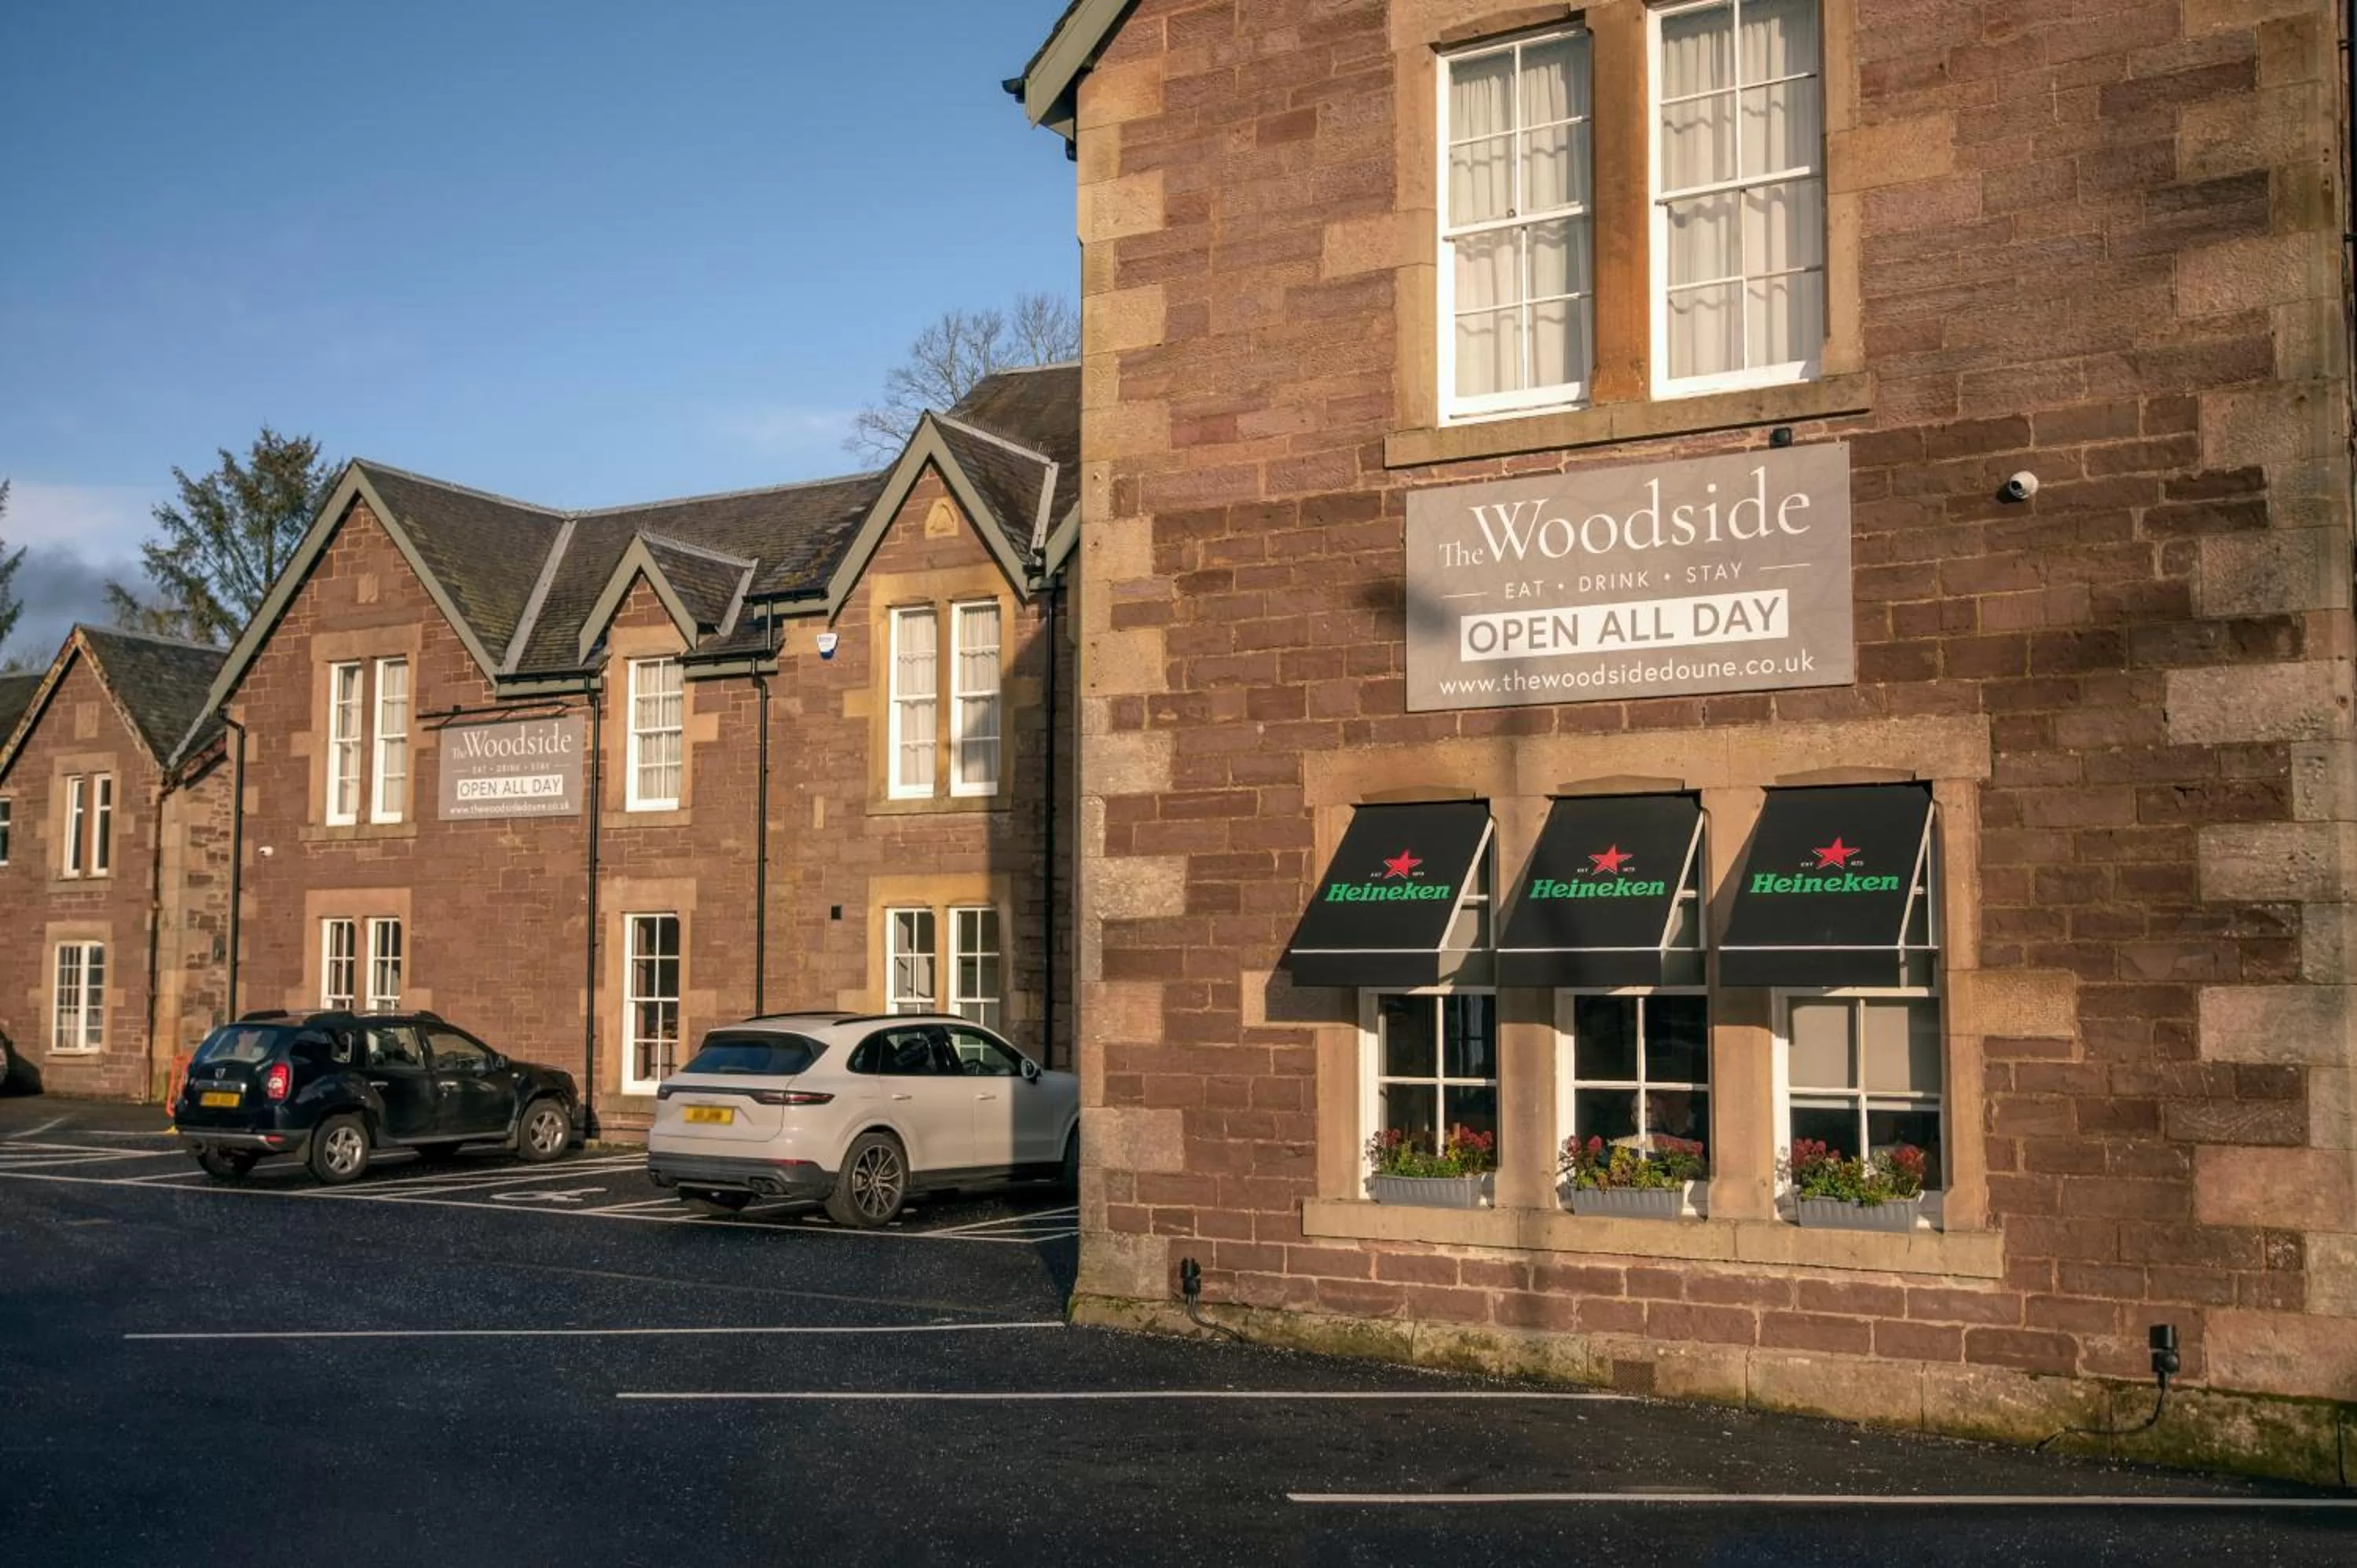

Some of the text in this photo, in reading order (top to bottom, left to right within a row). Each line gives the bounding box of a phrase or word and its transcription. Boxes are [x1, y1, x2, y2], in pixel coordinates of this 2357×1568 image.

[1439, 466, 1811, 567] The Woodside
[1505, 562, 1743, 599] EAT DRINK STAY
[1468, 596, 1780, 654] OPEN ALL DAY
[1439, 650, 1815, 694] www.thewoodsidedoune.co.uk
[453, 723, 572, 760] The Woodside
[472, 762, 549, 774] EAT DRINK STAY
[460, 778, 560, 797] OPEN ALL DAY
[1325, 882, 1450, 902] Heineken
[1530, 877, 1665, 899] Heineken
[1750, 873, 1899, 893] Heineken
